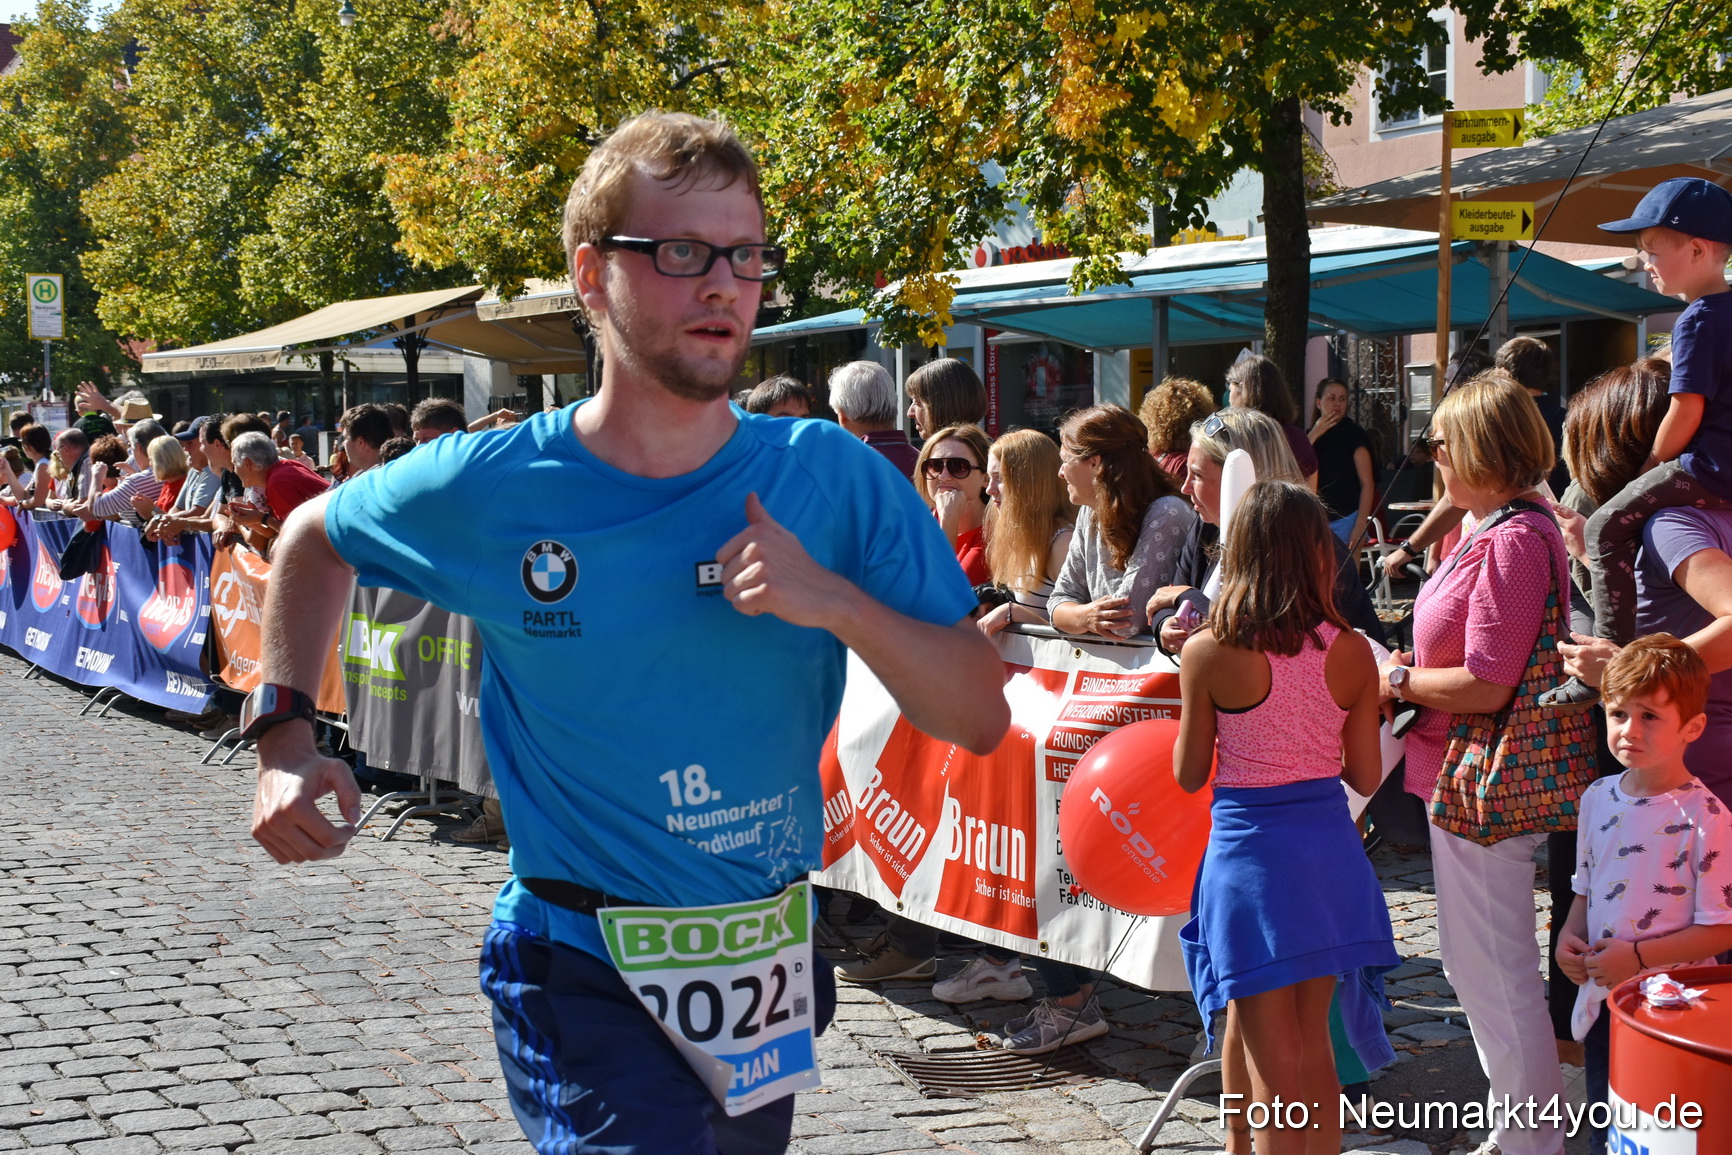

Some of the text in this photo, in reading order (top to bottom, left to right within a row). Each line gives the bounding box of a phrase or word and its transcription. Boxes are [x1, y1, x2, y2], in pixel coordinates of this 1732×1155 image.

[1461, 132, 1496, 145] ausgabe
[1459, 208, 1516, 220] Kleiderbeutel-
[1469, 223, 1504, 235] ausgabe
[39, 285, 51, 298] H
[526, 543, 572, 563] BMW
[523, 611, 581, 626] PARTL
[524, 627, 582, 639] Neumarkt
[230, 650, 261, 676] Agent
[1081, 676, 1146, 693] BINDESTRICKE
[1067, 704, 1172, 724] VERZURRSYSTEME
[659, 764, 722, 807] 18.
[666, 794, 784, 833] Neumarkter
[823, 789, 852, 833] aun
[856, 766, 926, 862] Braun
[829, 830, 845, 845] Sicher
[945, 796, 1026, 882] Braun
[869, 832, 910, 881] Sicher ist sicher
[1121, 843, 1160, 884] energie
[975, 877, 1036, 909] Sicher ist sicher
[1059, 888, 1079, 906] Fax
[616, 896, 795, 965] BOCK
[795, 962, 804, 974] D
